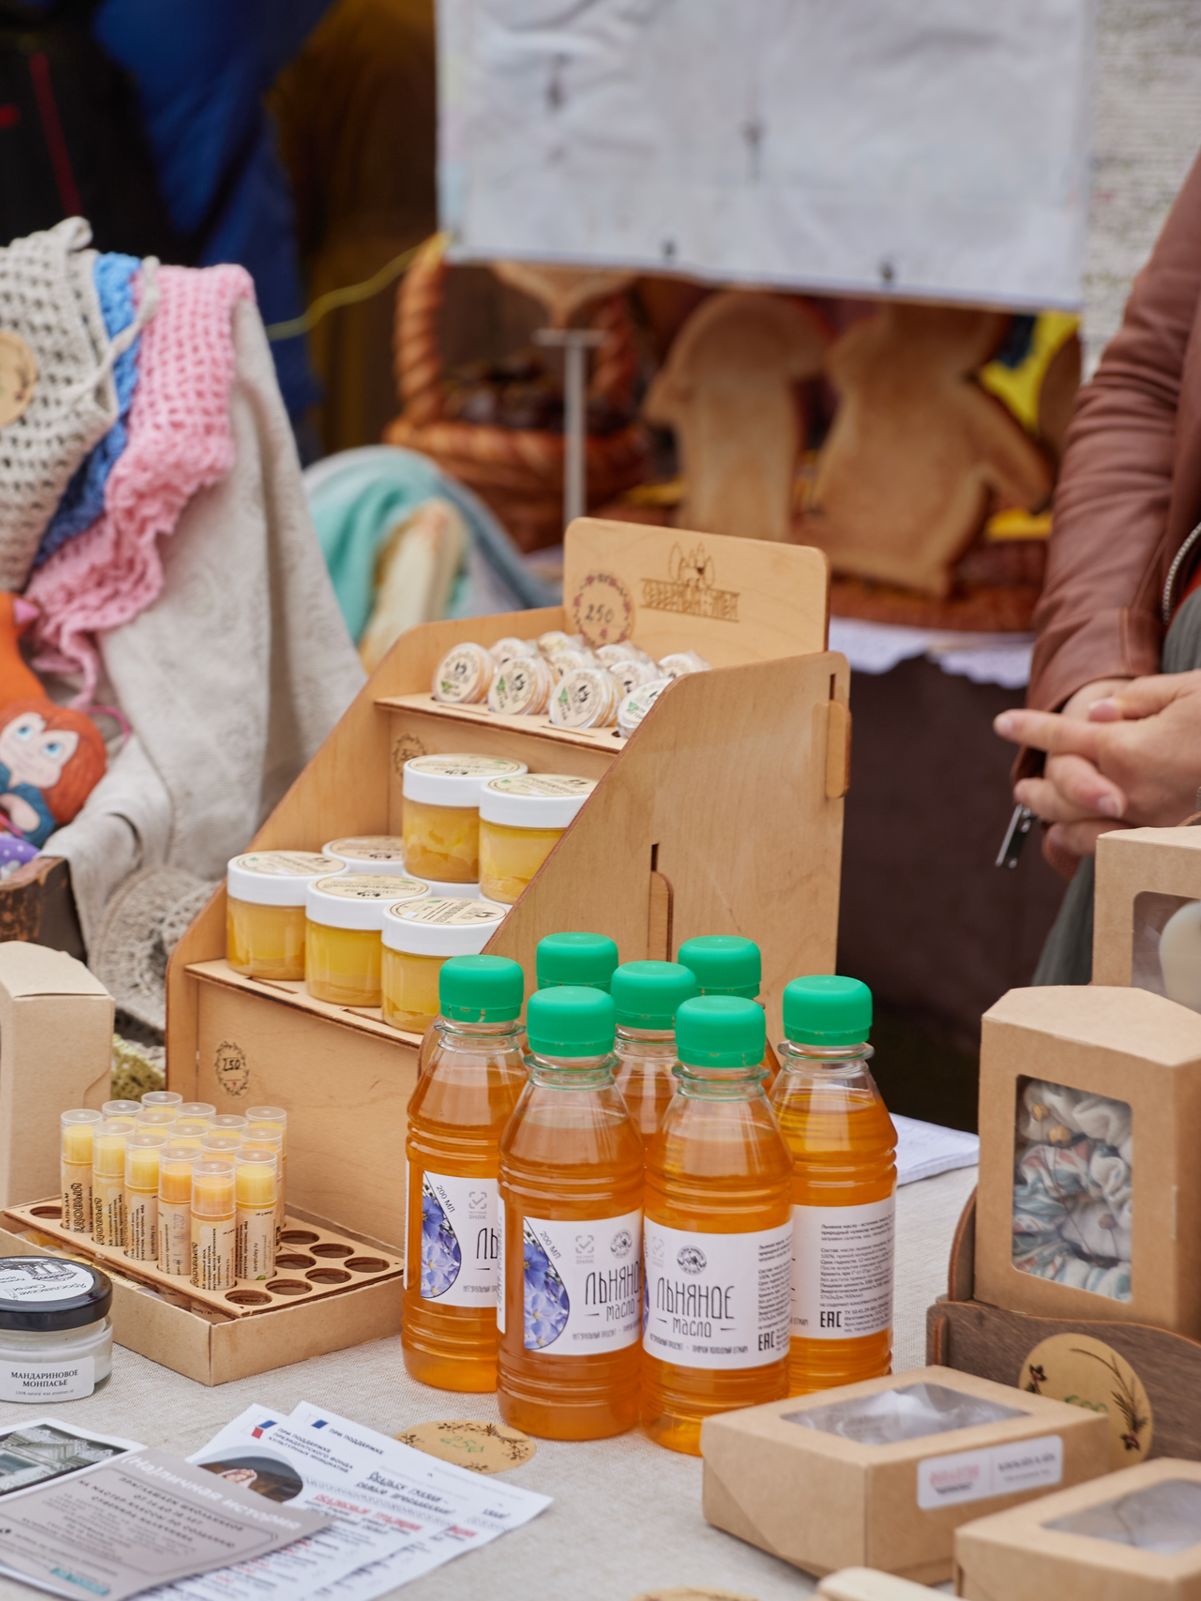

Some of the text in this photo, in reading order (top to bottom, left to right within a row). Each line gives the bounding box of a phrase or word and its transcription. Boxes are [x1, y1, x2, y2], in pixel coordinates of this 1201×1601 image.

[585, 603, 614, 623] 250
[436, 1185, 456, 1213] 200 МЛ
[540, 1230, 563, 1260] 200 МЛ
[585, 1260, 642, 1306] ЛЬНЯНО
[656, 1277, 735, 1320] ЛЬНЯНОЕ
[820, 1311, 841, 1327] EAC
[11, 1369, 79, 1381] МАНДАРИНОВОЕ
[22, 1379, 68, 1387] МОНПАСЬЕ
